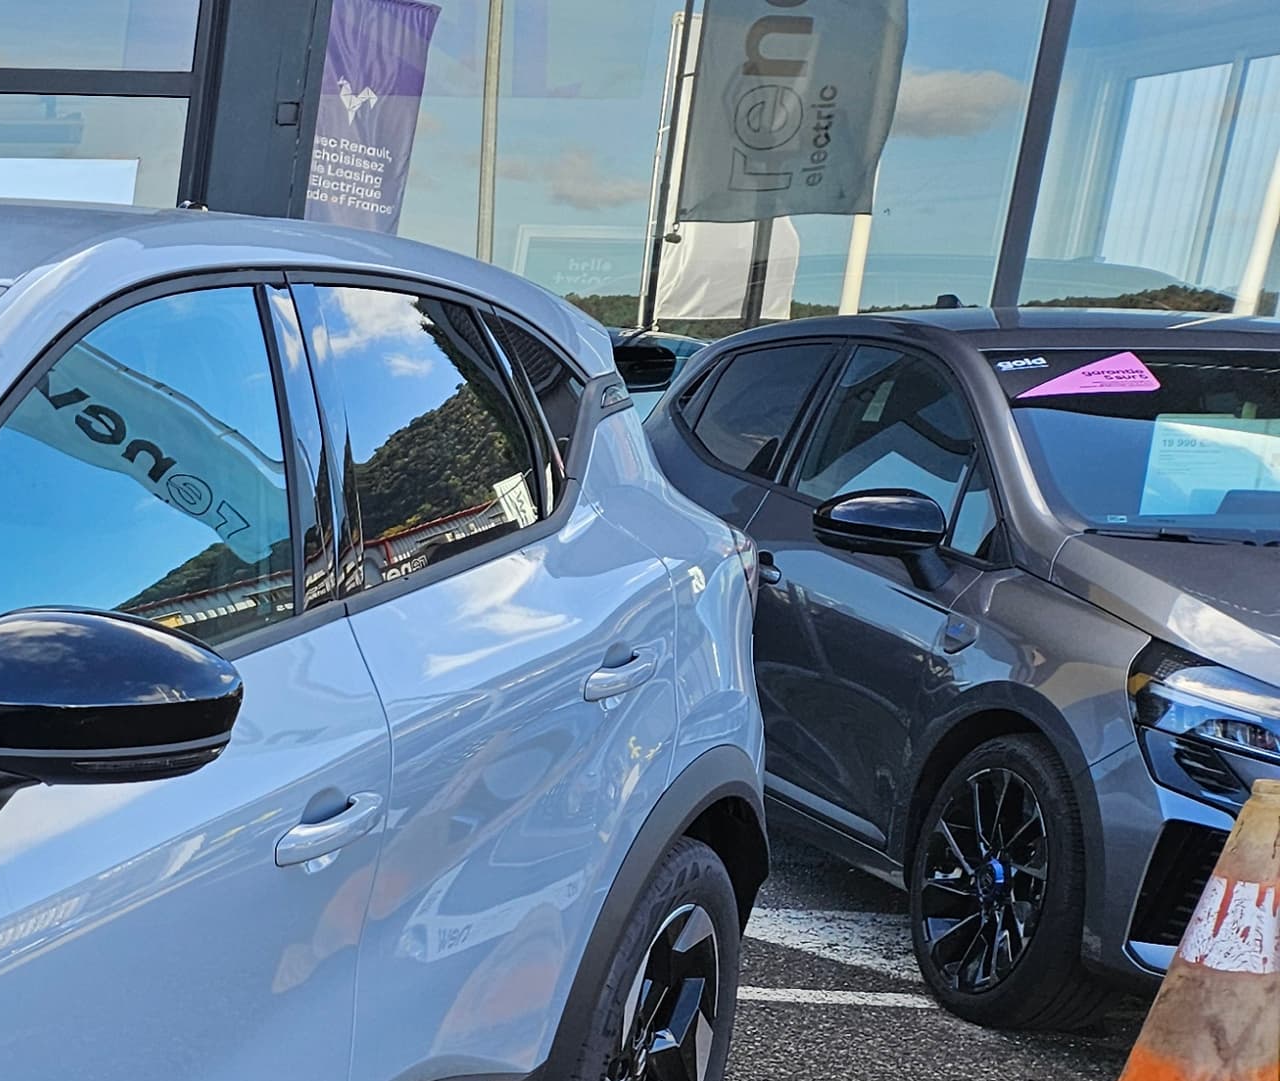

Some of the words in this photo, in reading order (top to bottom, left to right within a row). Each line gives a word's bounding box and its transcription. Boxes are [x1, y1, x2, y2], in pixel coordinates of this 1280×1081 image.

[801, 84, 838, 187] electric
[313, 149, 385, 172] choisissez
[340, 139, 393, 163] Renault,
[310, 175, 382, 199] Electrique
[327, 165, 383, 188] Leasing
[996, 356, 1048, 370] gold
[1081, 367, 1145, 377] garantie
